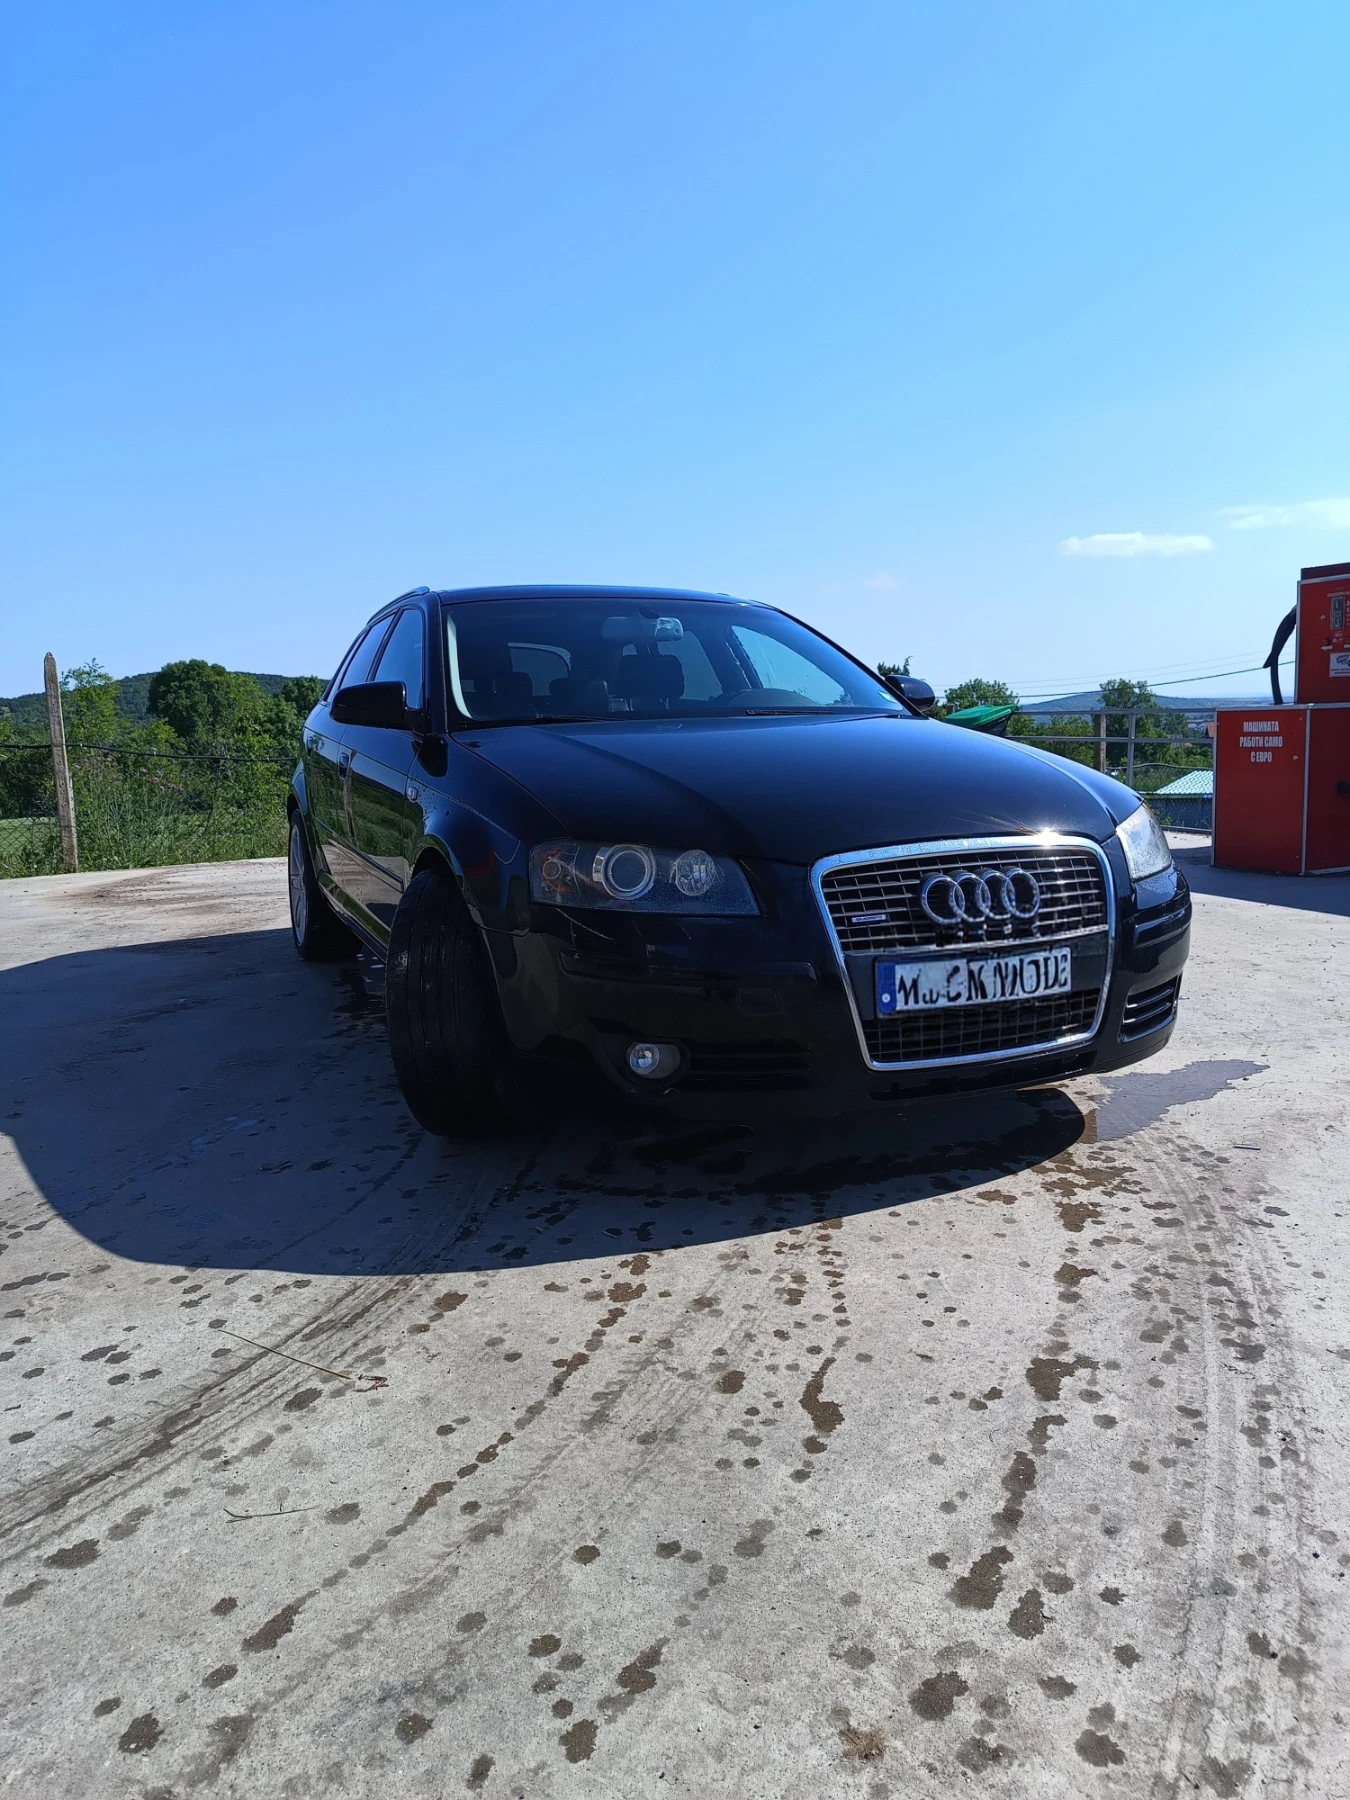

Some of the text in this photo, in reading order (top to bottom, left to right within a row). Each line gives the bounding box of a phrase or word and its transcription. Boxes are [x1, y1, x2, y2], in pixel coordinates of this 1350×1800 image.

[1243, 721, 1279, 732] МАШИНАТА
[1239, 736, 1283, 747] РАБОТИ САМО
[1250, 751, 1272, 762] С ЕВРО
